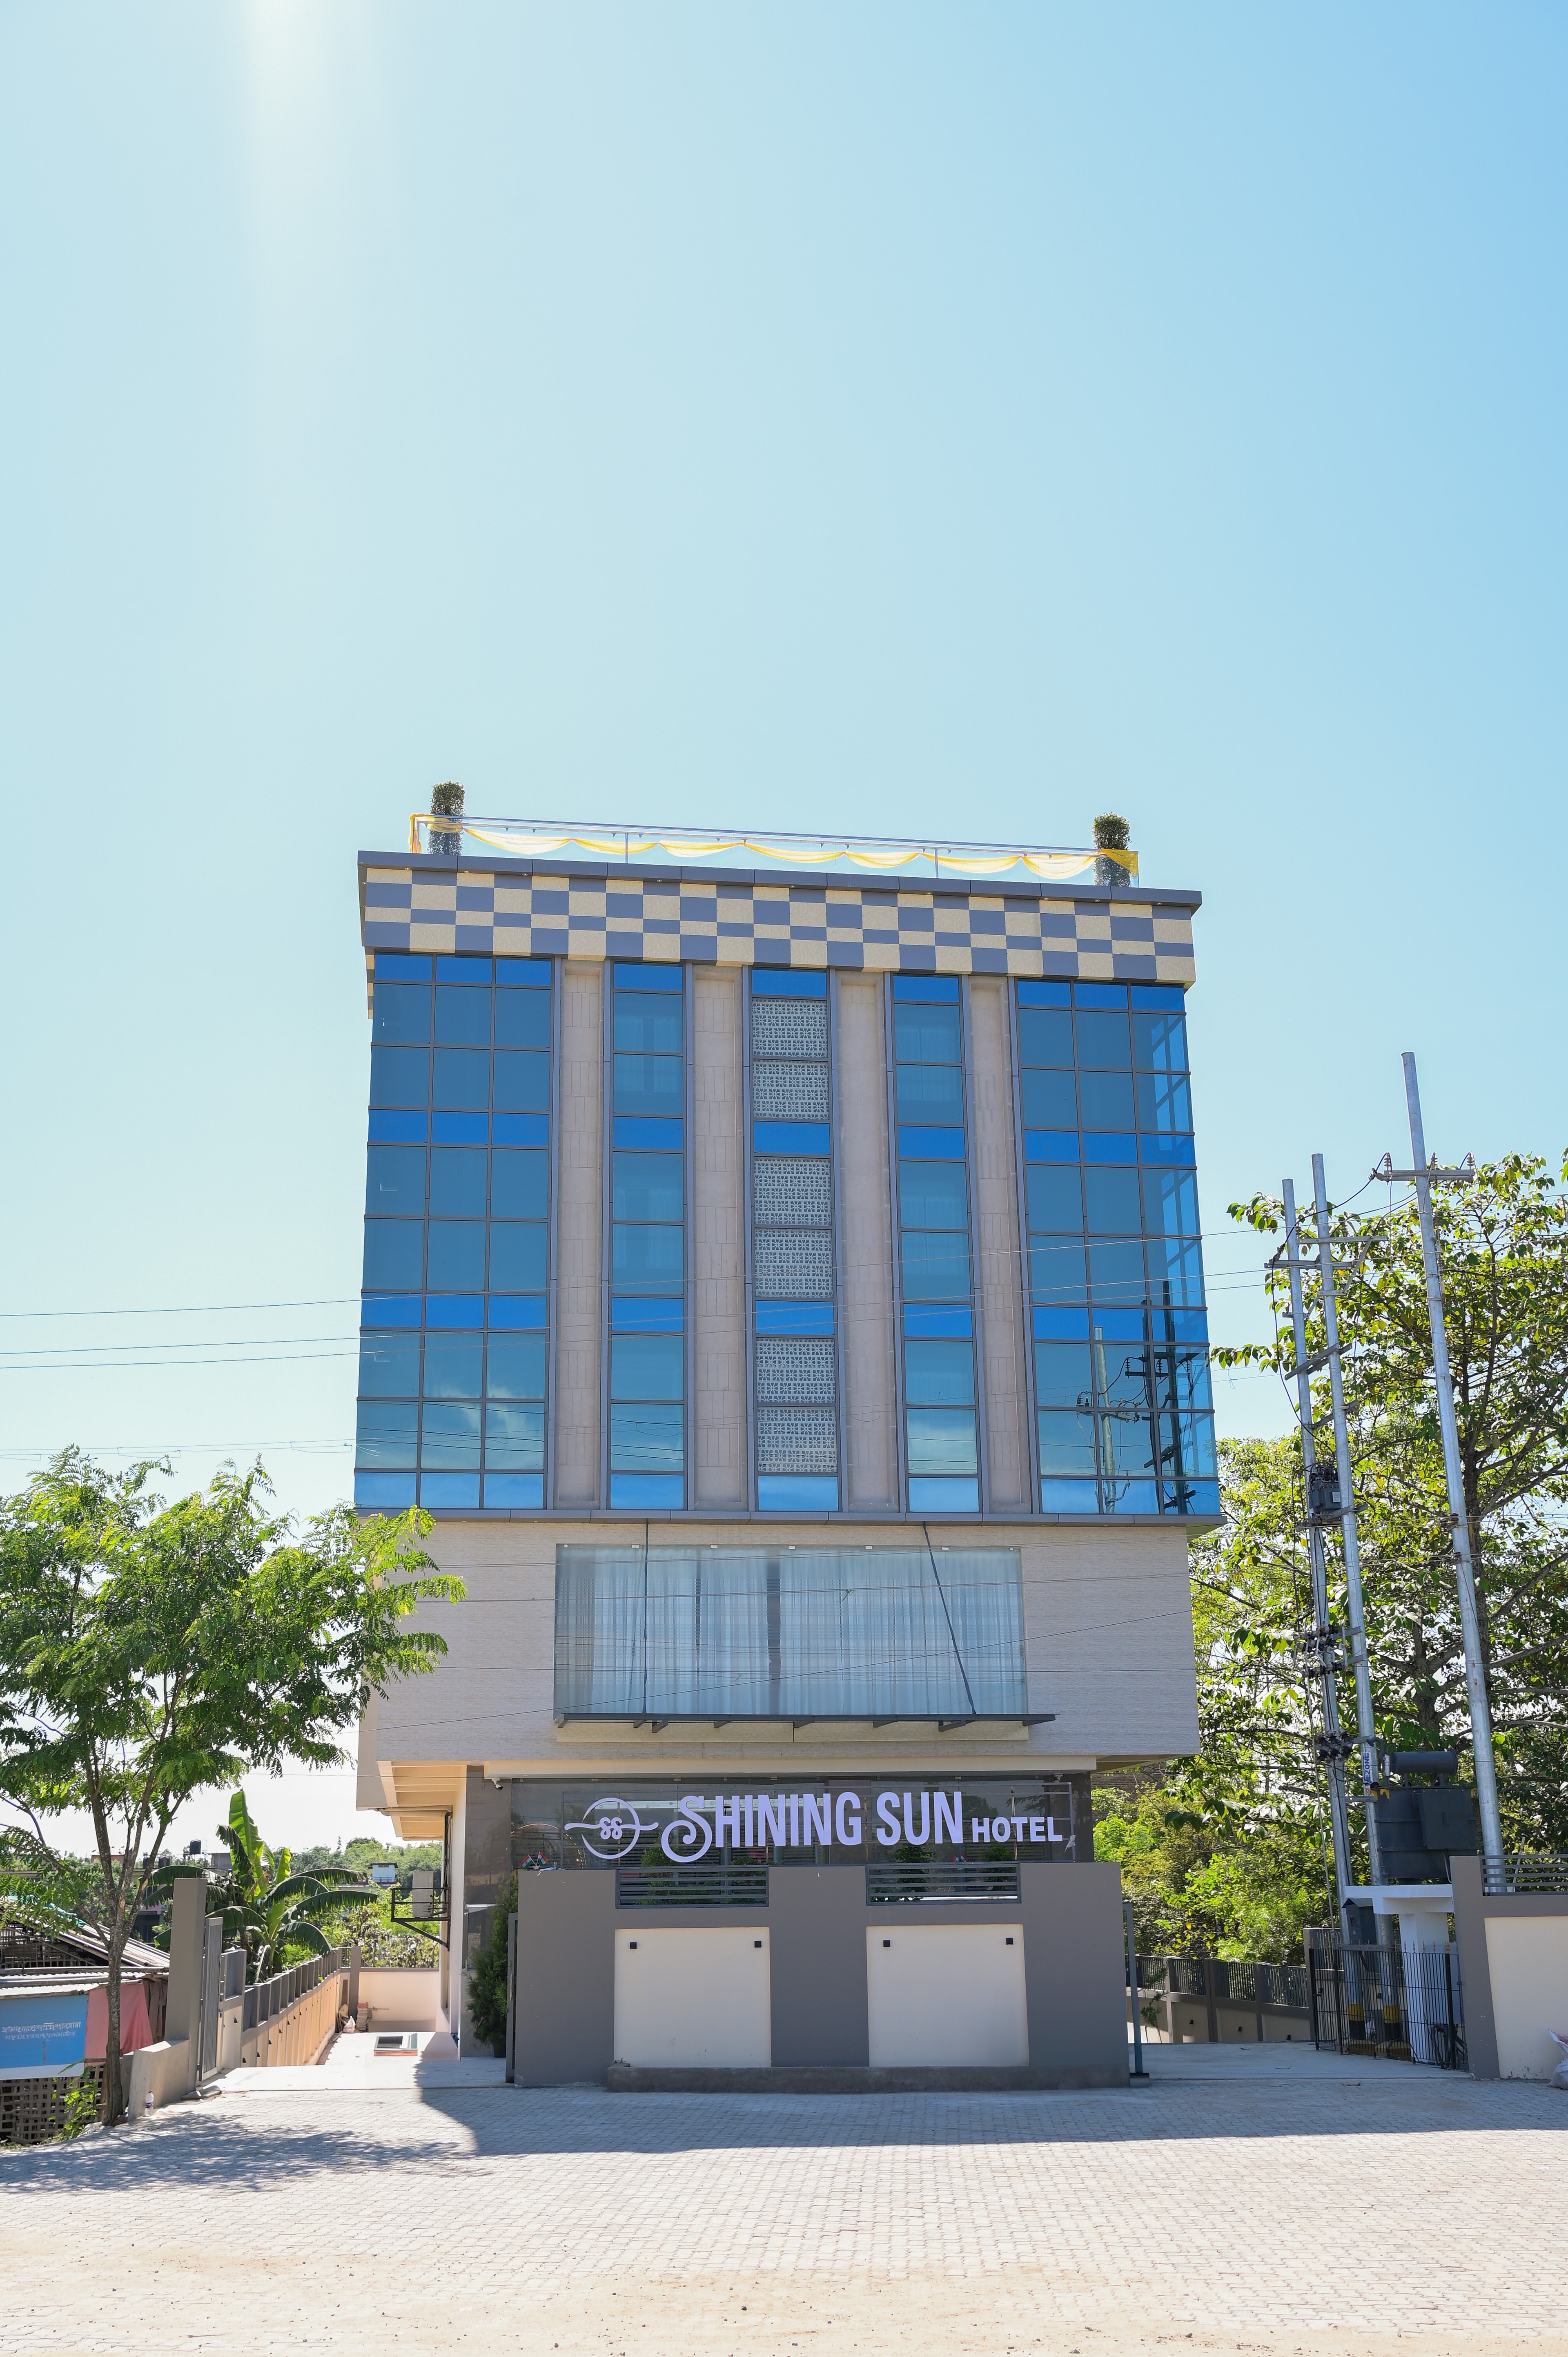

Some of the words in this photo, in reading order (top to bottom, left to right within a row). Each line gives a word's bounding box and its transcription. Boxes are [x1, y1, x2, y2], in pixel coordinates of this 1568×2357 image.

[661, 1791, 862, 1862] SHINING
[876, 1791, 964, 1846] SUN
[972, 1817, 1062, 1842] HOTEL
